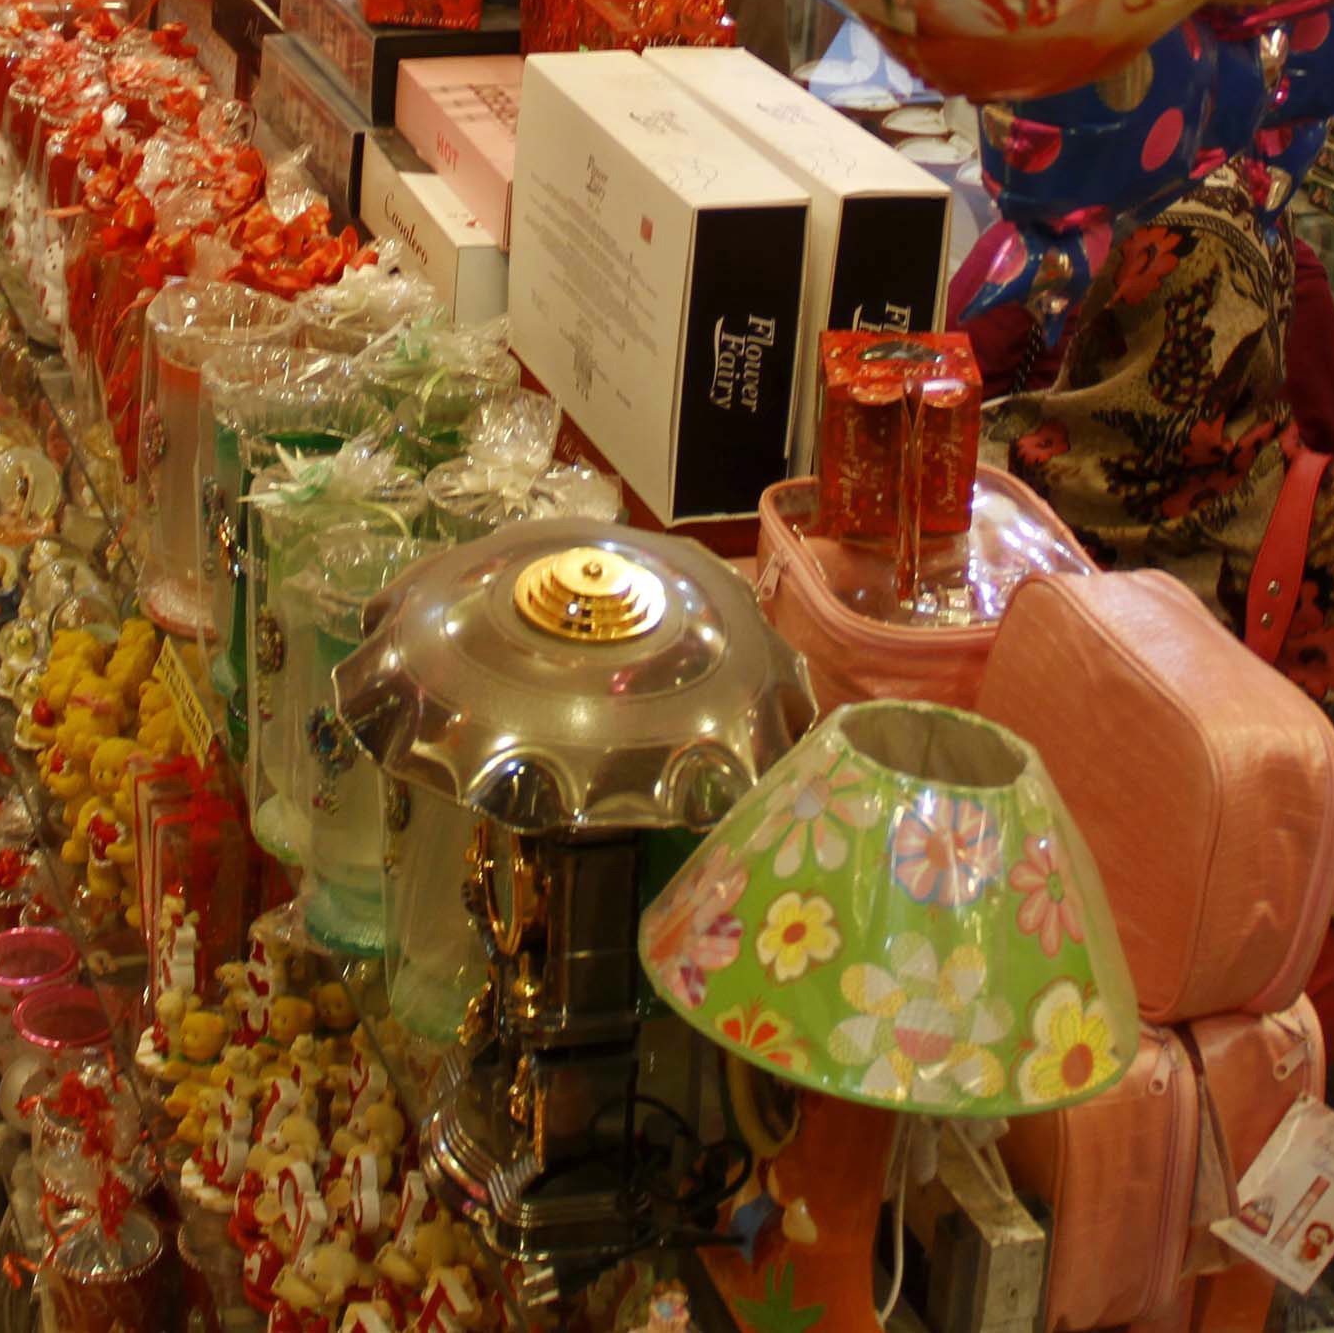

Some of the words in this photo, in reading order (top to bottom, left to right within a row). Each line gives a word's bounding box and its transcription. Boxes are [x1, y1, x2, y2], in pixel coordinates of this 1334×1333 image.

[436, 131, 459, 171] HOT
[713, 328, 749, 412] Fairy
[741, 314, 776, 413] Flower
